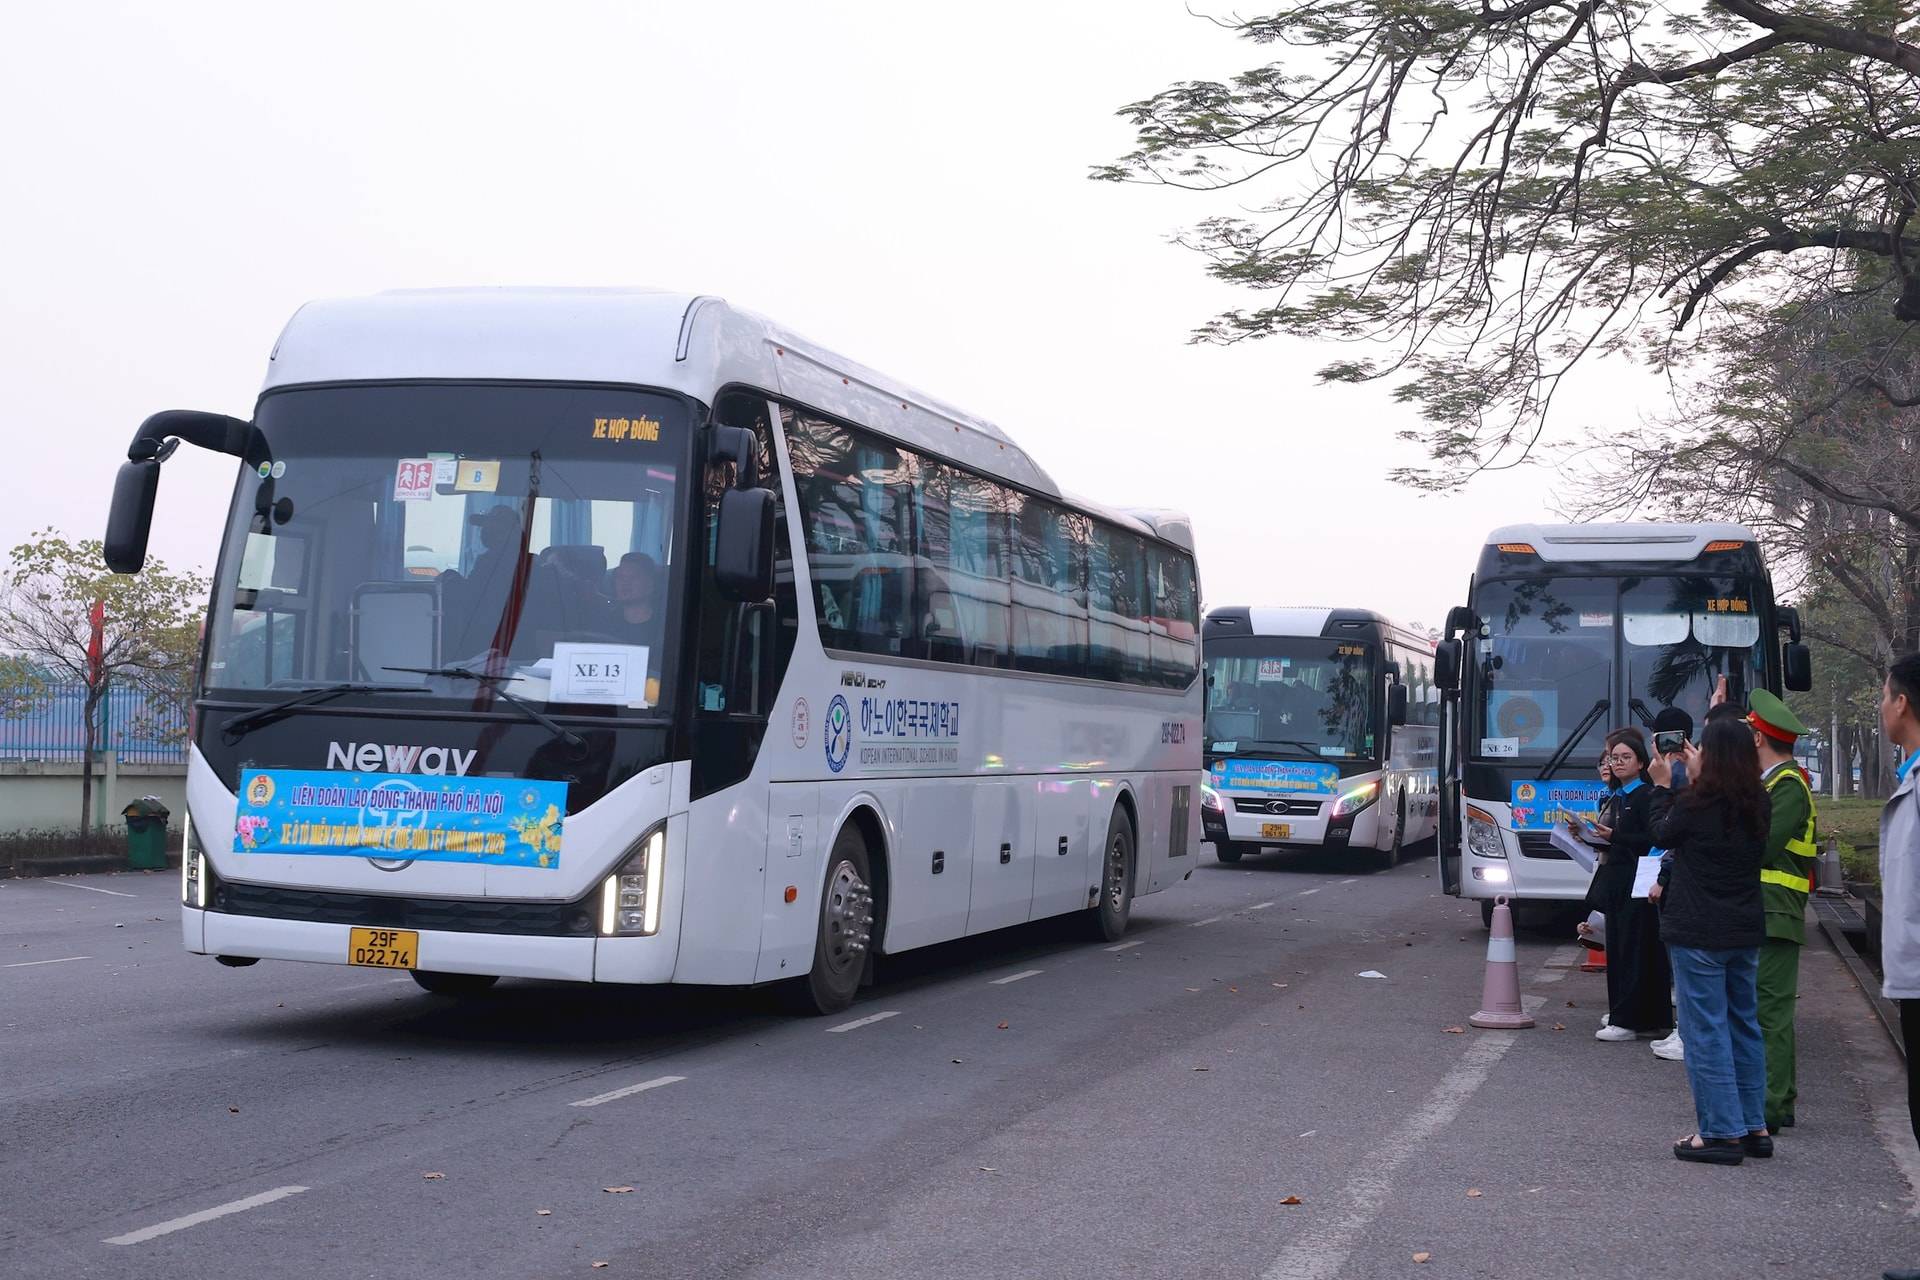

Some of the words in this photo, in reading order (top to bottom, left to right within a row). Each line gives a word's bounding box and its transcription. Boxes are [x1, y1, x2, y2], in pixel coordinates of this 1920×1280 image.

[592, 418, 607, 439] XE
[608, 417, 630, 443] HỢP
[473, 470, 482, 483] B
[1707, 599, 1716, 611] XE
[575, 663, 599, 677] XE
[605, 663, 621, 677] 13
[861, 696, 959, 737] 하노이한국국제학교
[1487, 743, 1501, 753] XE
[1503, 744, 1513, 752] 26
[326, 741, 478, 777] Neway
[292, 782, 315, 806] LIÊN
[317, 783, 347, 807] ĐOÀN
[348, 786, 369, 808] LAO
[369, 785, 401, 812] ĐỘNG
[403, 786, 438, 812] THÀNH
[440, 784, 465, 813] PHỐ
[483, 790, 505, 819] NỘI
[1585, 790, 1599, 801] LAO
[369, 931, 398, 947] 29F
[356, 948, 409, 967] 022.74
